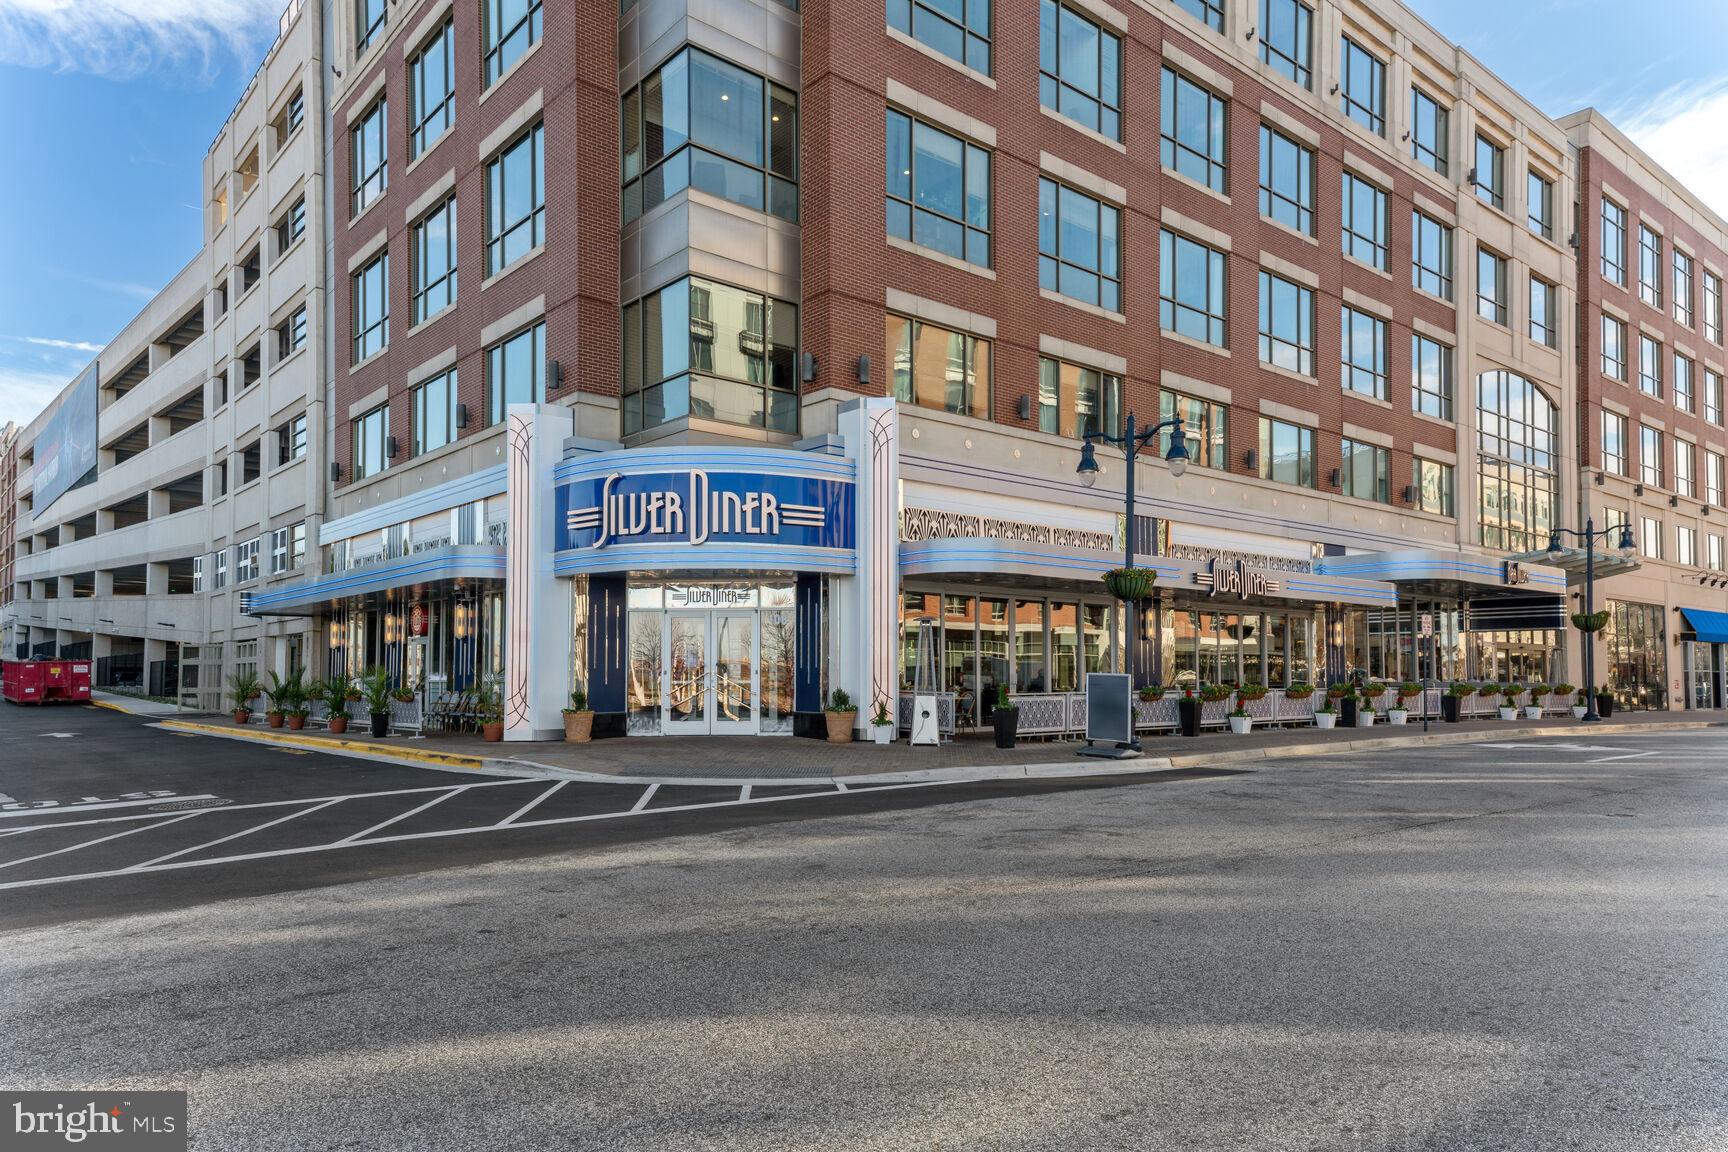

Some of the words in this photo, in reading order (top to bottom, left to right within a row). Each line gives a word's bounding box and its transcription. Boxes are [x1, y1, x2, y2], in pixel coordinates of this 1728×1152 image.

[593, 471, 684, 549] SILVER
[690, 468, 780, 546] DINER
[684, 584, 711, 606] SILVER
[712, 584, 738, 606] DINER
[1209, 556, 1240, 597] SILVER
[1240, 559, 1267, 600] DINER
